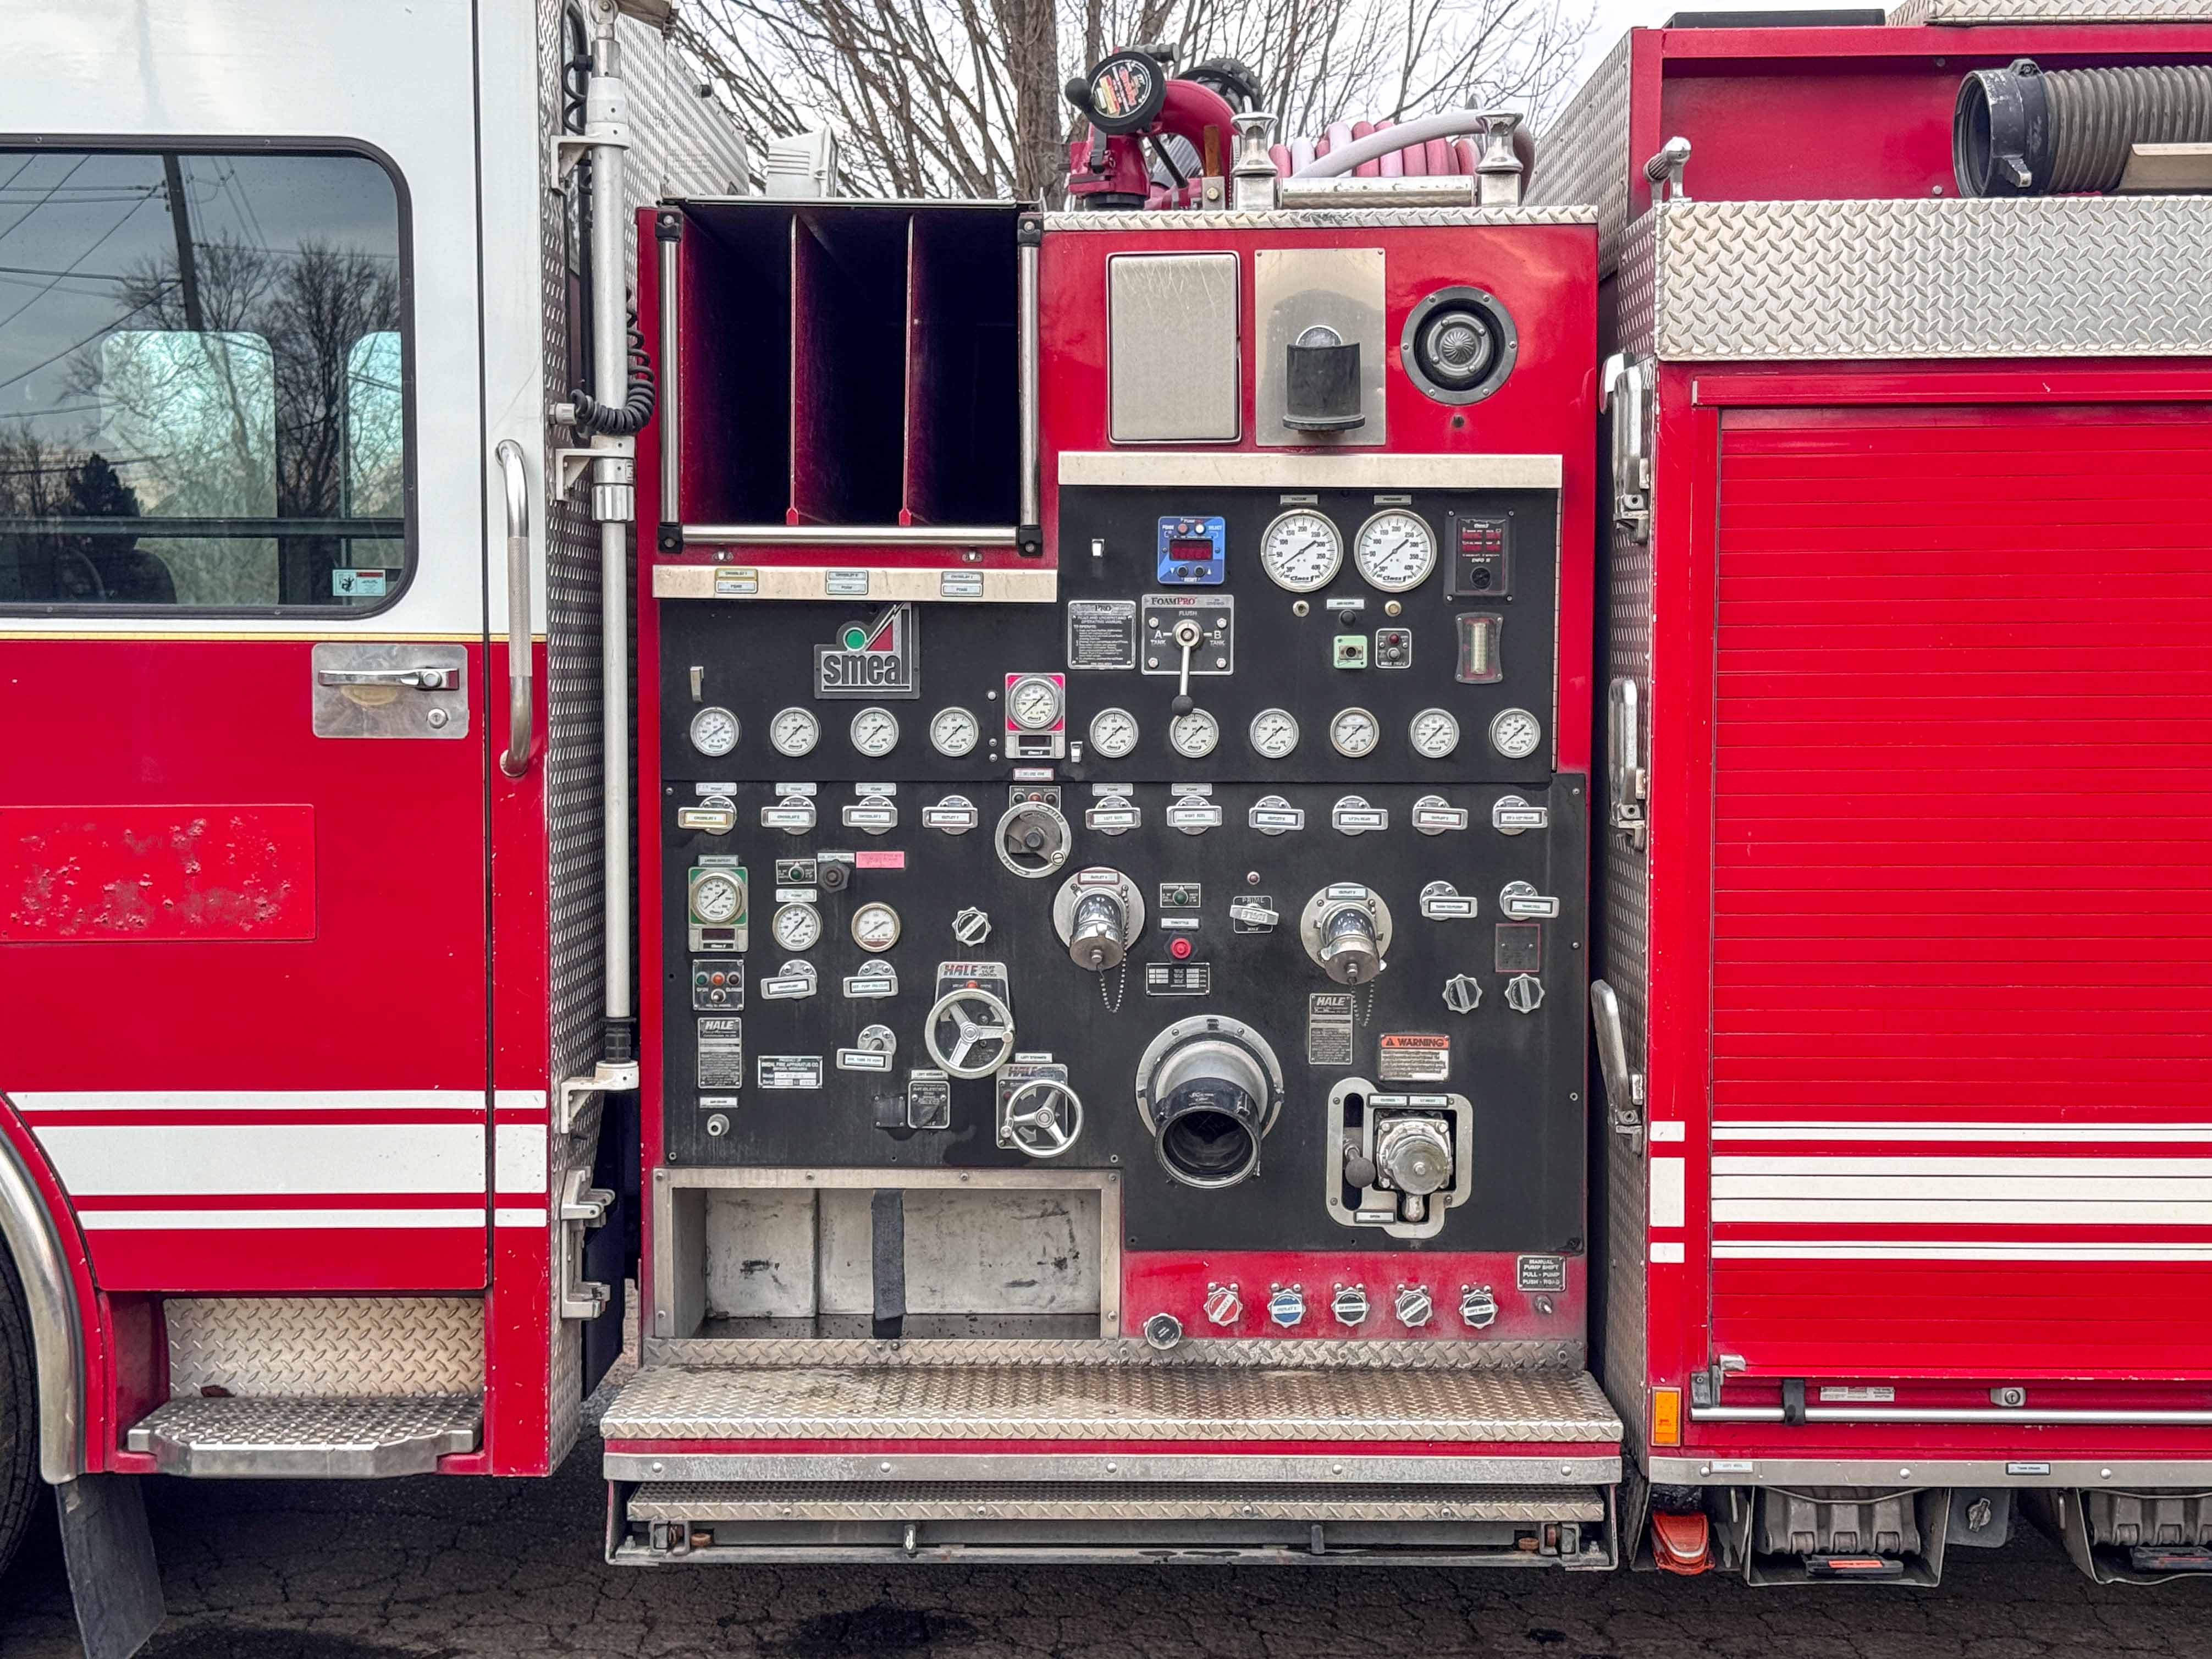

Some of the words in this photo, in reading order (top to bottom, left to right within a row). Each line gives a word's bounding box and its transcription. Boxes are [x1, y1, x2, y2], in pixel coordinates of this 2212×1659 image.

[823, 654, 910, 685] smeal
[944, 965, 978, 976] HALE
[1315, 996, 1346, 1006] HALE
[705, 1021, 734, 1030] HALE
[1398, 1038, 1444, 1047] WARNING
